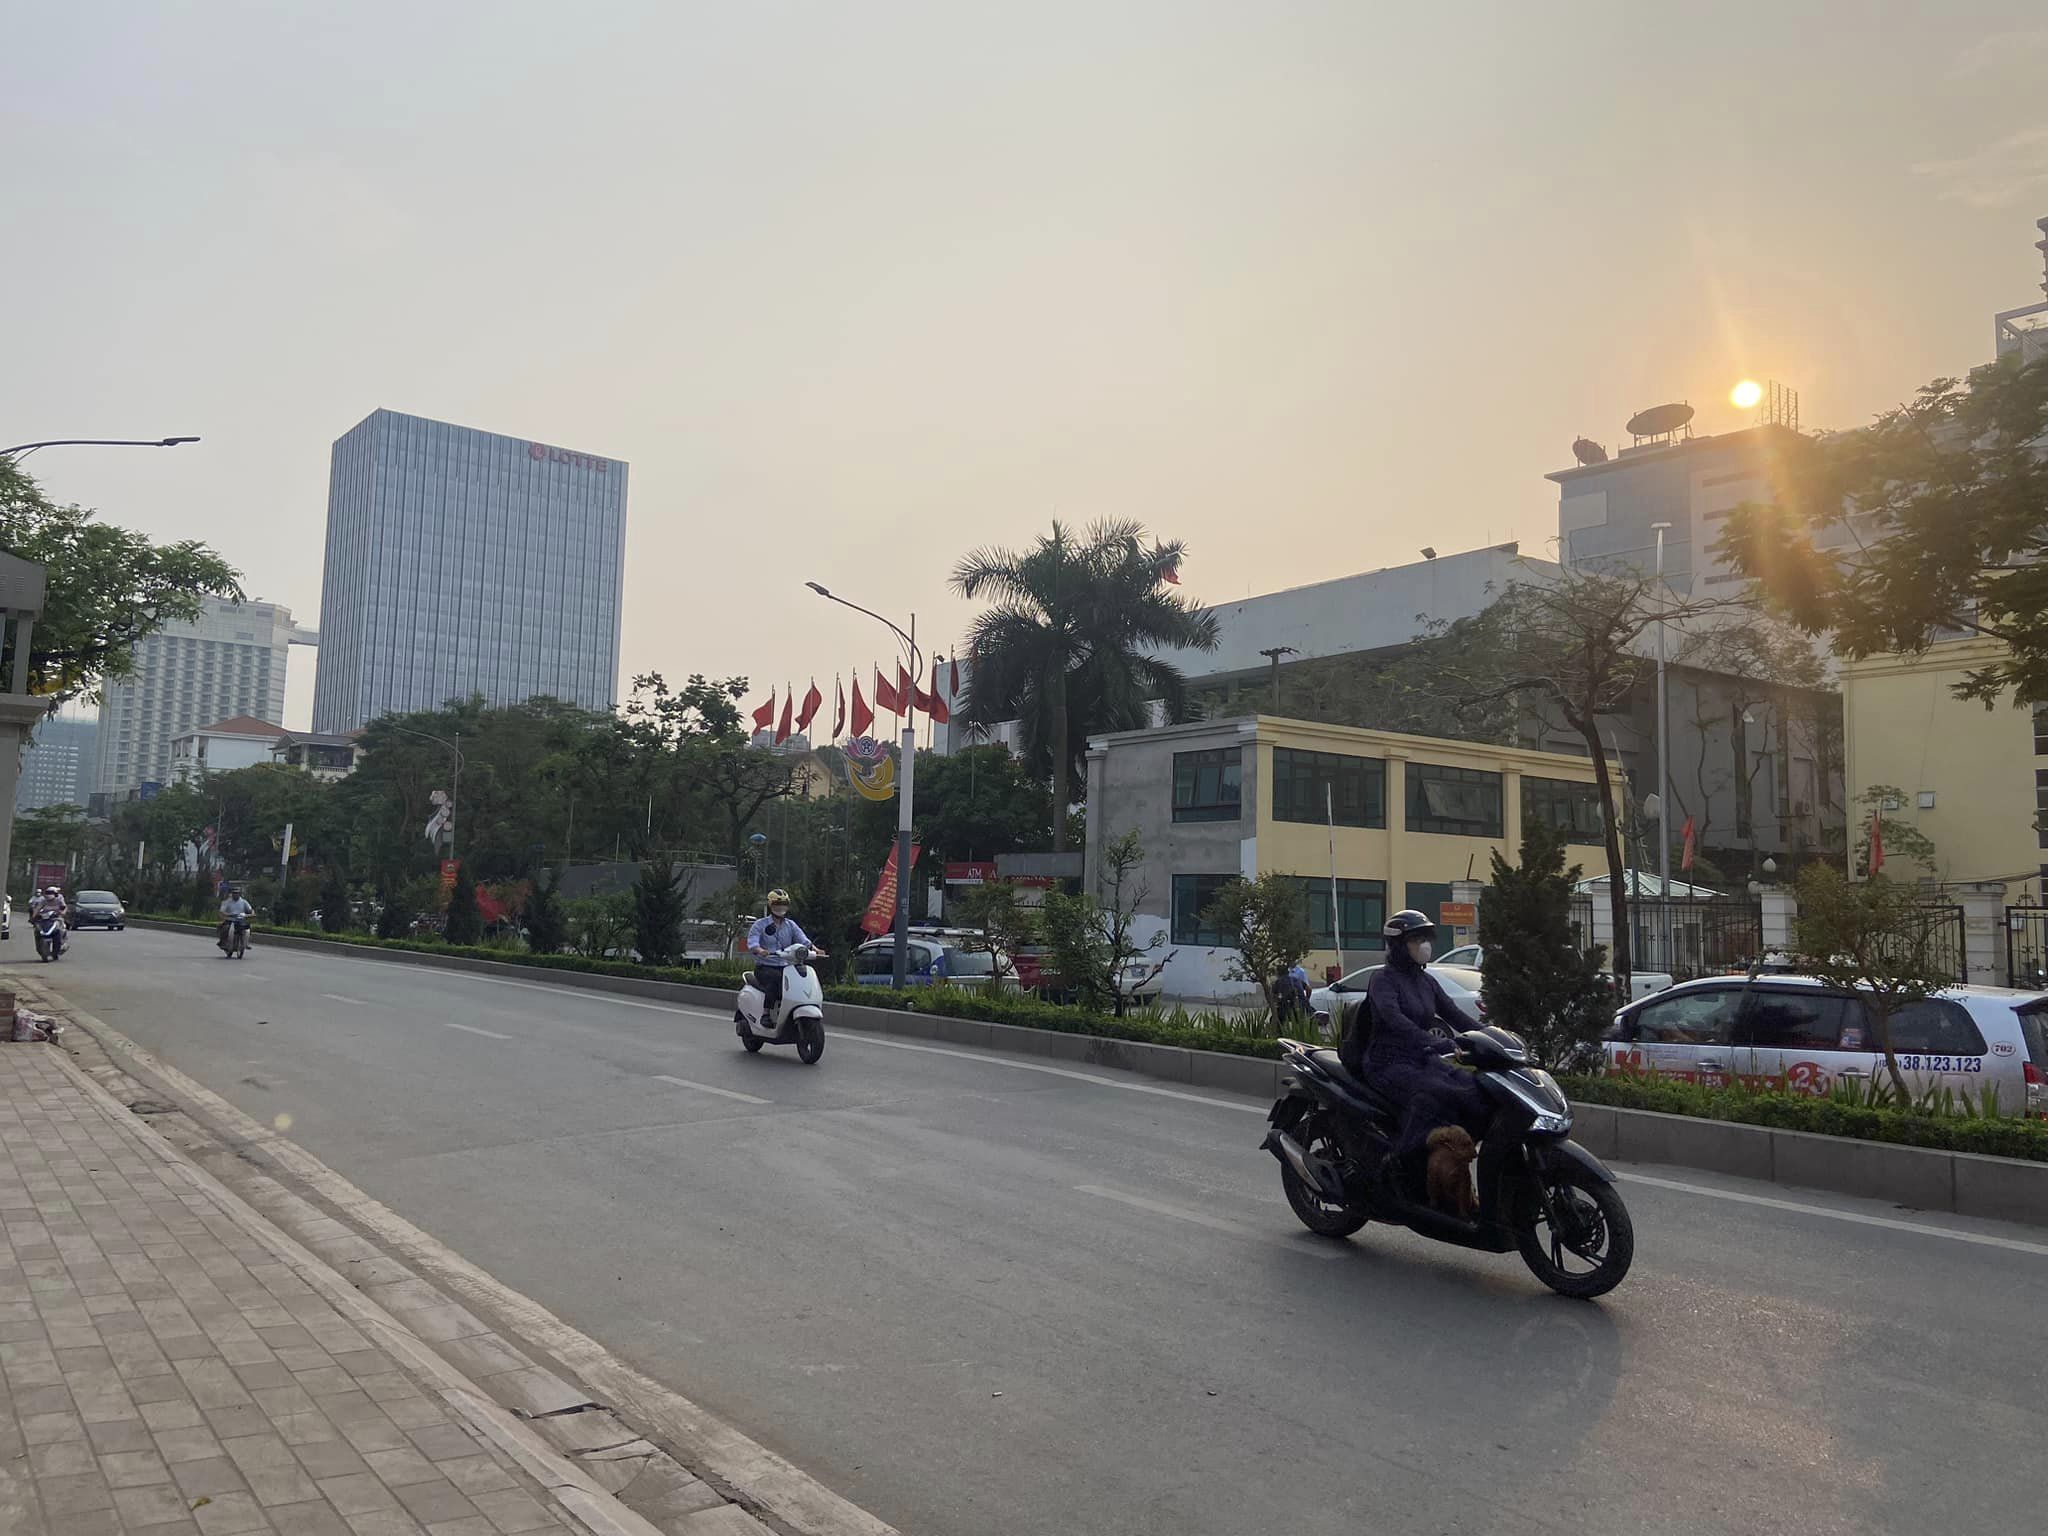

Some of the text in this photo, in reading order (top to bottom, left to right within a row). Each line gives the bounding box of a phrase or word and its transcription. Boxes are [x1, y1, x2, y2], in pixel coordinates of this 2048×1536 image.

[549, 447, 608, 472] LOTTE
[967, 867, 982, 879] ATM
[1994, 1044, 2013, 1053] 702
[1903, 1055, 1981, 1073] 38.123.123
